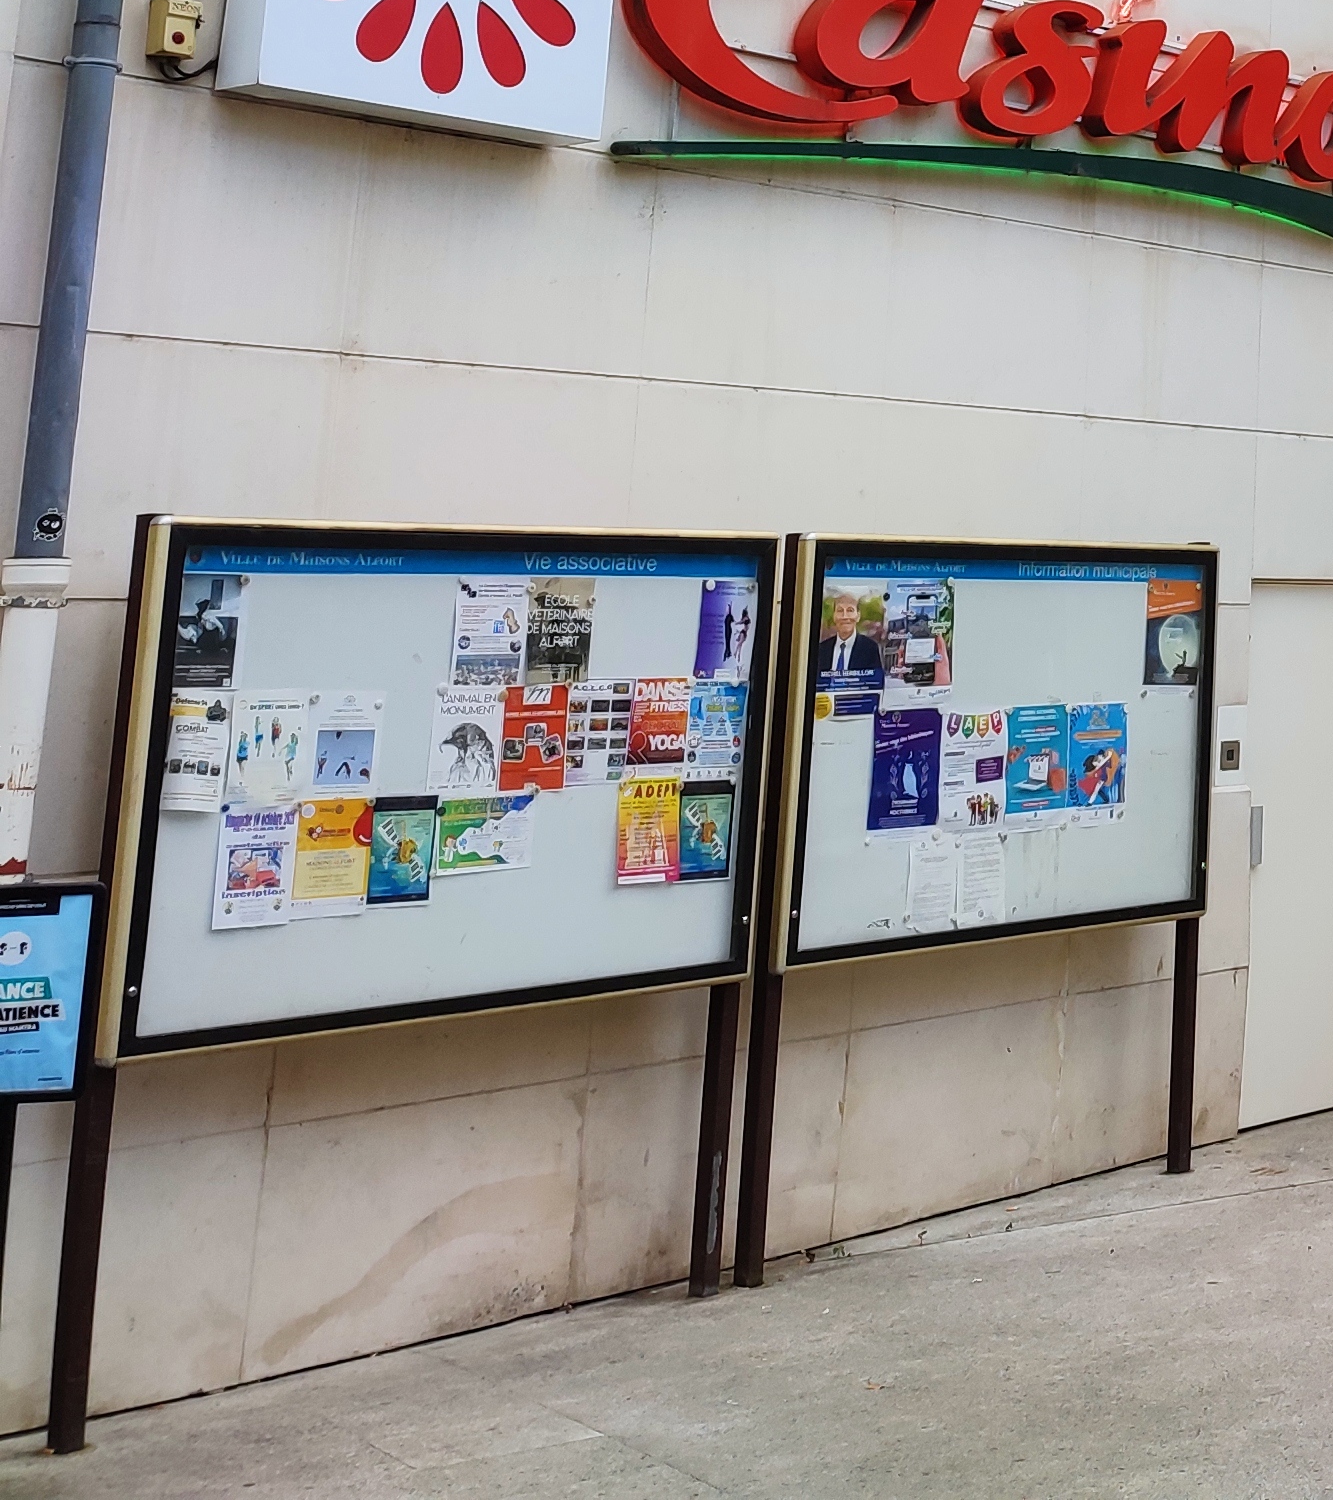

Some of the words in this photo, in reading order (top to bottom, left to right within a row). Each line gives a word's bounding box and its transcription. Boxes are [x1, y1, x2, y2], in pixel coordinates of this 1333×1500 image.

[524, 552, 551, 570] Vie
[557, 554, 658, 571] associative
[1018, 562, 1090, 578] Information
[1093, 565, 1157, 581] municipale
[542, 622, 591, 634] MAISONS
[635, 681, 691, 701] DANSE
[440, 705, 496, 716] MONUMENT
[648, 734, 686, 751] YOGA
